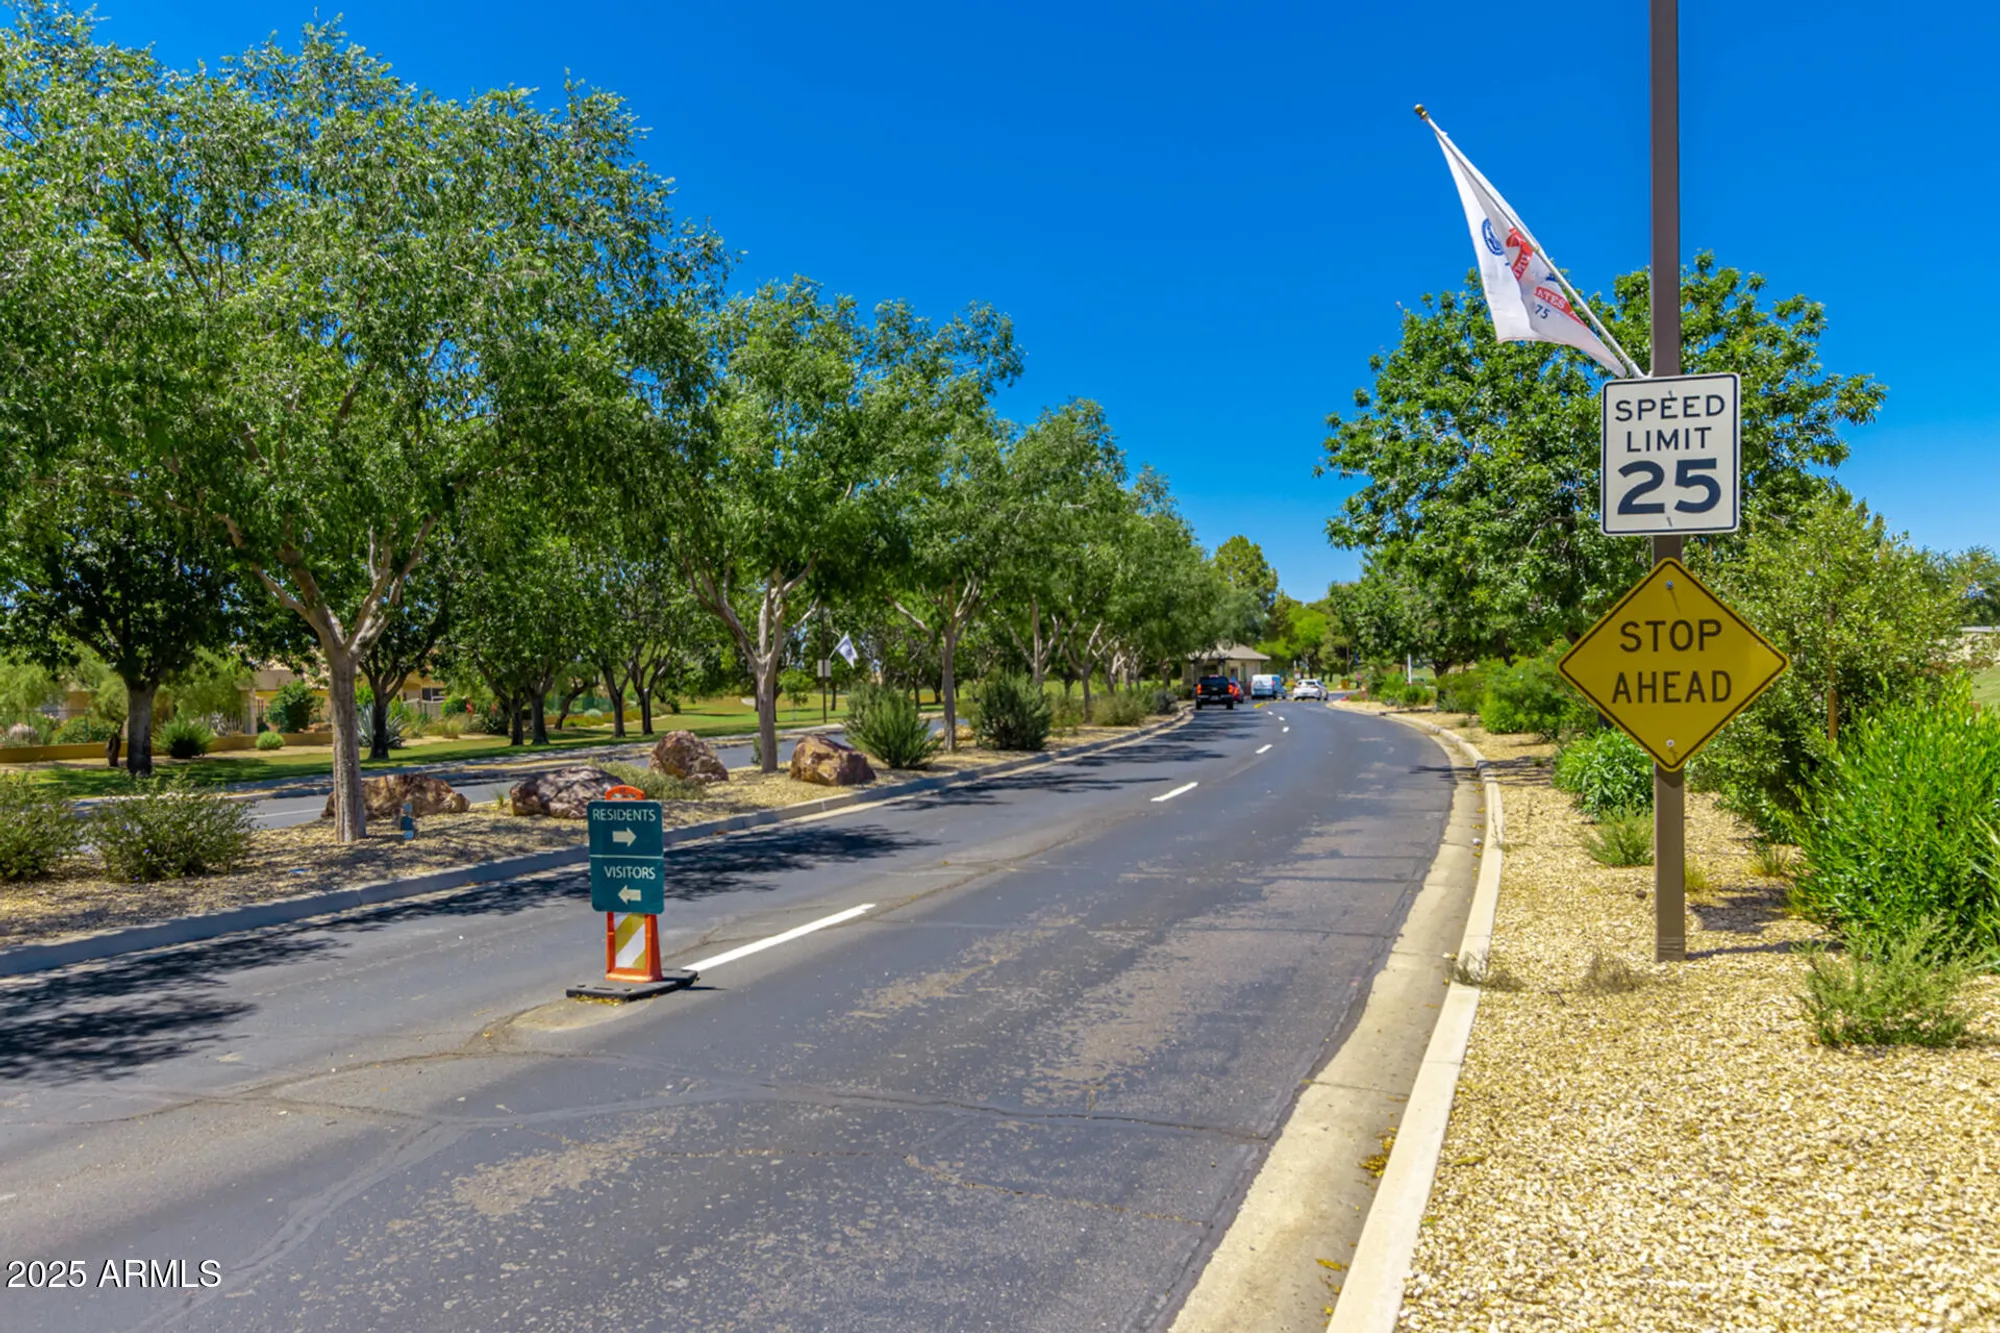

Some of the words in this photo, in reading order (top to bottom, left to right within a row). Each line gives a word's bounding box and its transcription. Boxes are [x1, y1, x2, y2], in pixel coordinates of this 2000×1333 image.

[1615, 395, 1725, 421] SPEED
[1627, 427, 1712, 452] LIMIT
[1617, 458, 1721, 515] 25
[1619, 619, 1722, 652] STOP
[1611, 670, 1732, 704] AHEAD
[592, 808, 656, 822] RESIDENTS
[604, 866, 656, 880] VISITORS
